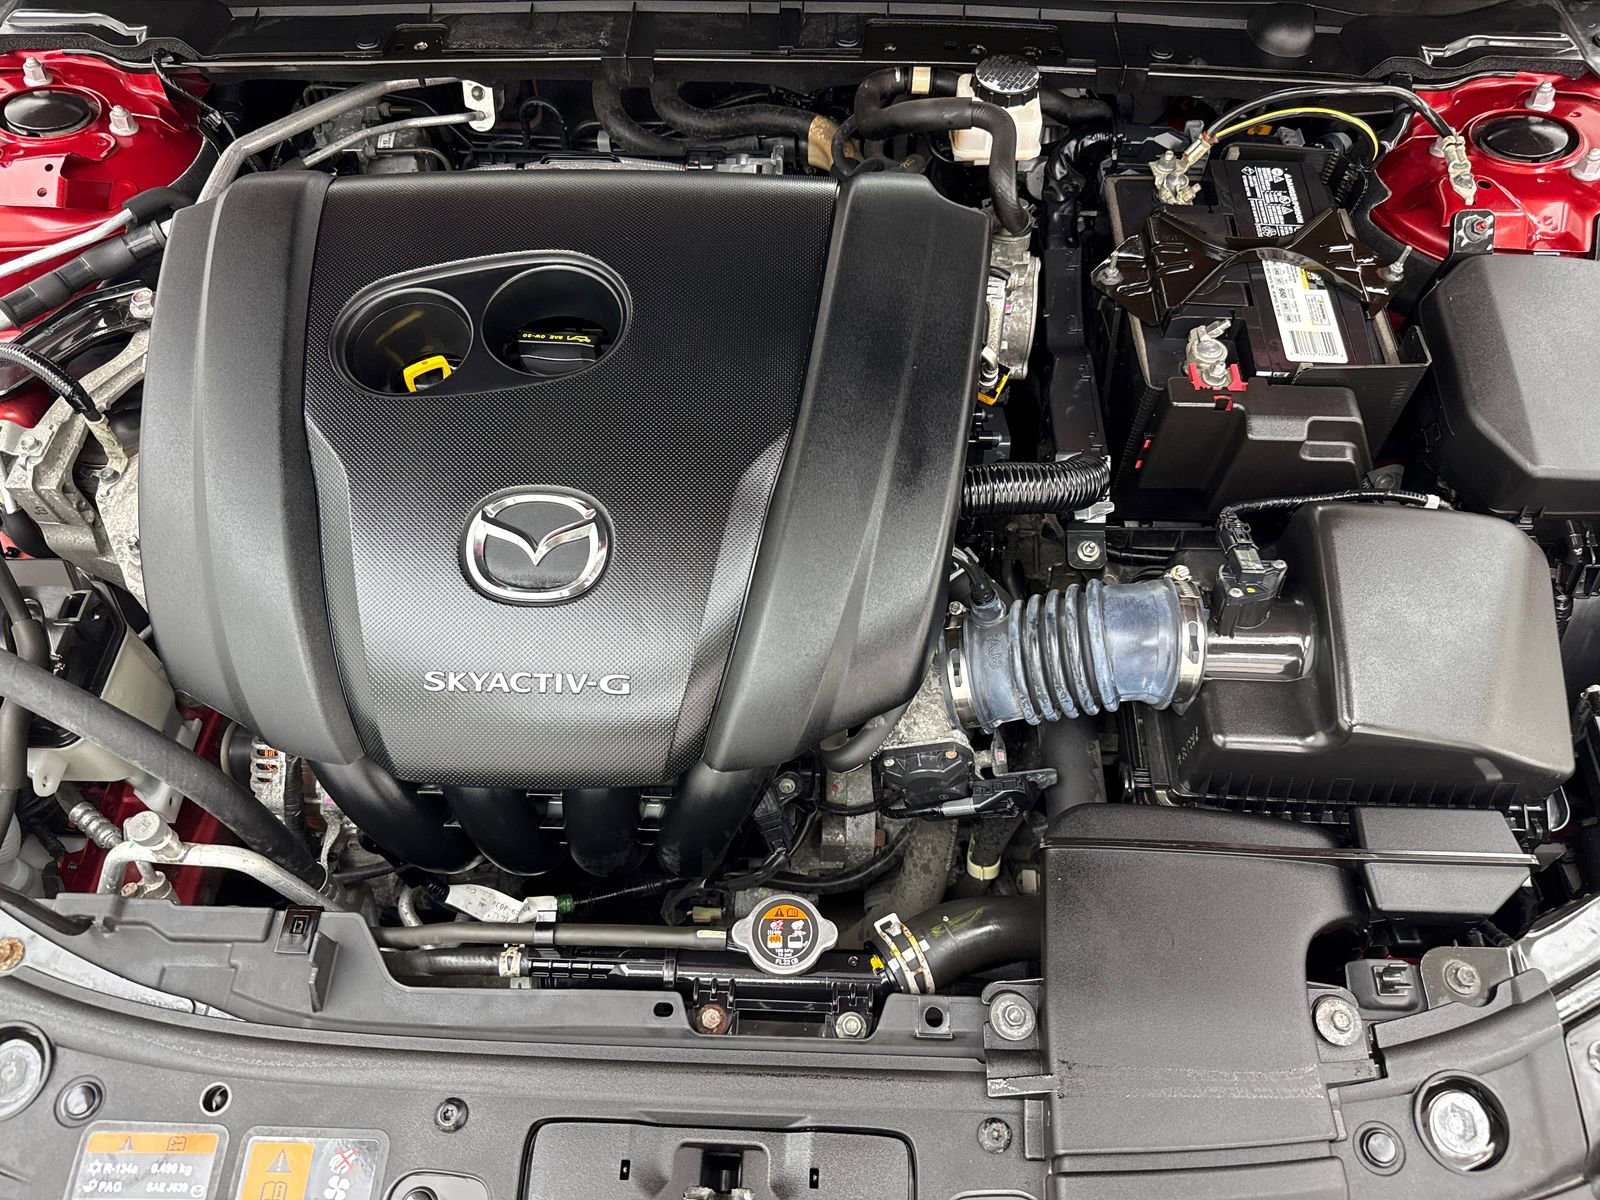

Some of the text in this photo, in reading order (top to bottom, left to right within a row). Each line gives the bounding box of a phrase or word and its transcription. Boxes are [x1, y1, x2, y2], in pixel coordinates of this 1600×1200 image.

[423, 671, 632, 695] SKYACTIV-G
[775, 957, 791, 966] FL22
[103, 1161, 139, 1175] R-134a
[179, 1163, 193, 1176] kg
[97, 1181, 189, 1193] PAG SAE J639
